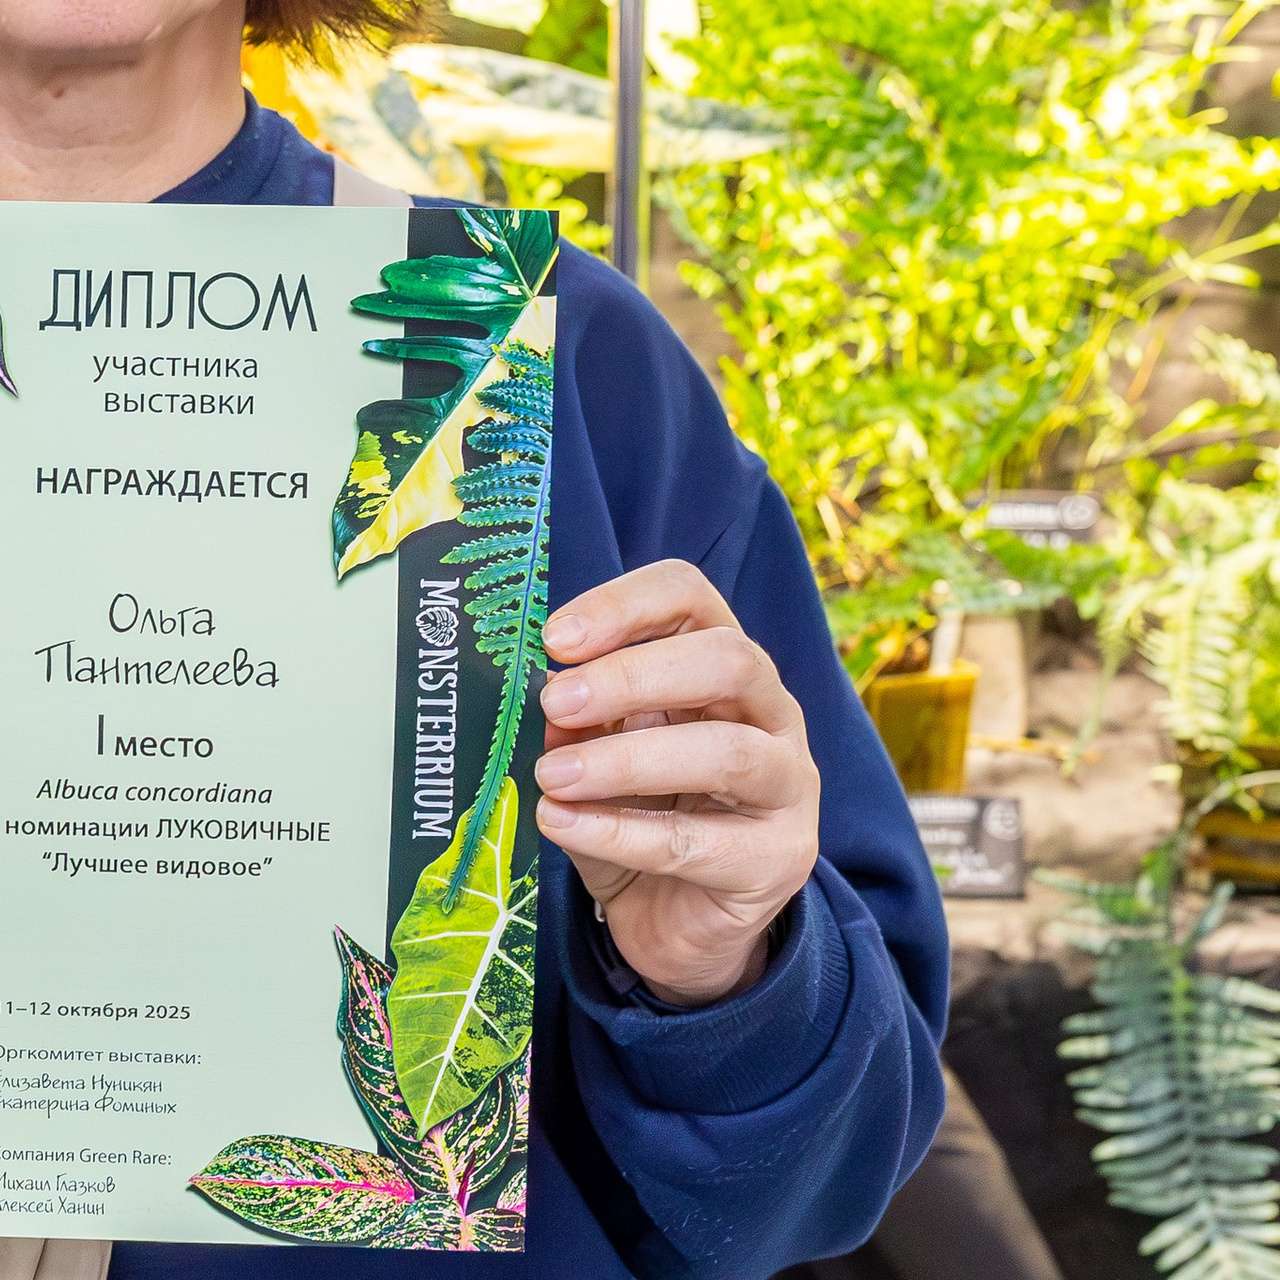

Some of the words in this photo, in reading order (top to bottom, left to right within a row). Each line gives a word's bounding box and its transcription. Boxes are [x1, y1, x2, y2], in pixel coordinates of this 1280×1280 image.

[38, 268, 318, 333] ДИПЛОМ
[92, 354, 258, 383] участника
[104, 392, 255, 415] выставки
[36, 466, 308, 504] НАГРАЖДАЕТСЯ
[108, 592, 217, 638] Ольга
[34, 639, 280, 688] Пантелеева
[114, 735, 214, 759] место
[35, 778, 119, 801] Albuca
[124, 781, 273, 804] concordiana
[5, 819, 149, 841] номинации
[155, 818, 331, 842] ЛУКОВИЧНЫЕ
[57, 1002, 138, 1022] октября
[144, 1004, 191, 1020] 2025
[108, 1051, 202, 1065] выставки:
[91, 1073, 163, 1098] Нуникян
[94, 1092, 178, 1115] Фоминых
[79, 1147, 128, 1164] Green
[132, 1149, 172, 1166] Rare:
[56, 1172, 116, 1196] Глазков
[57, 1195, 105, 1216] Ханин
